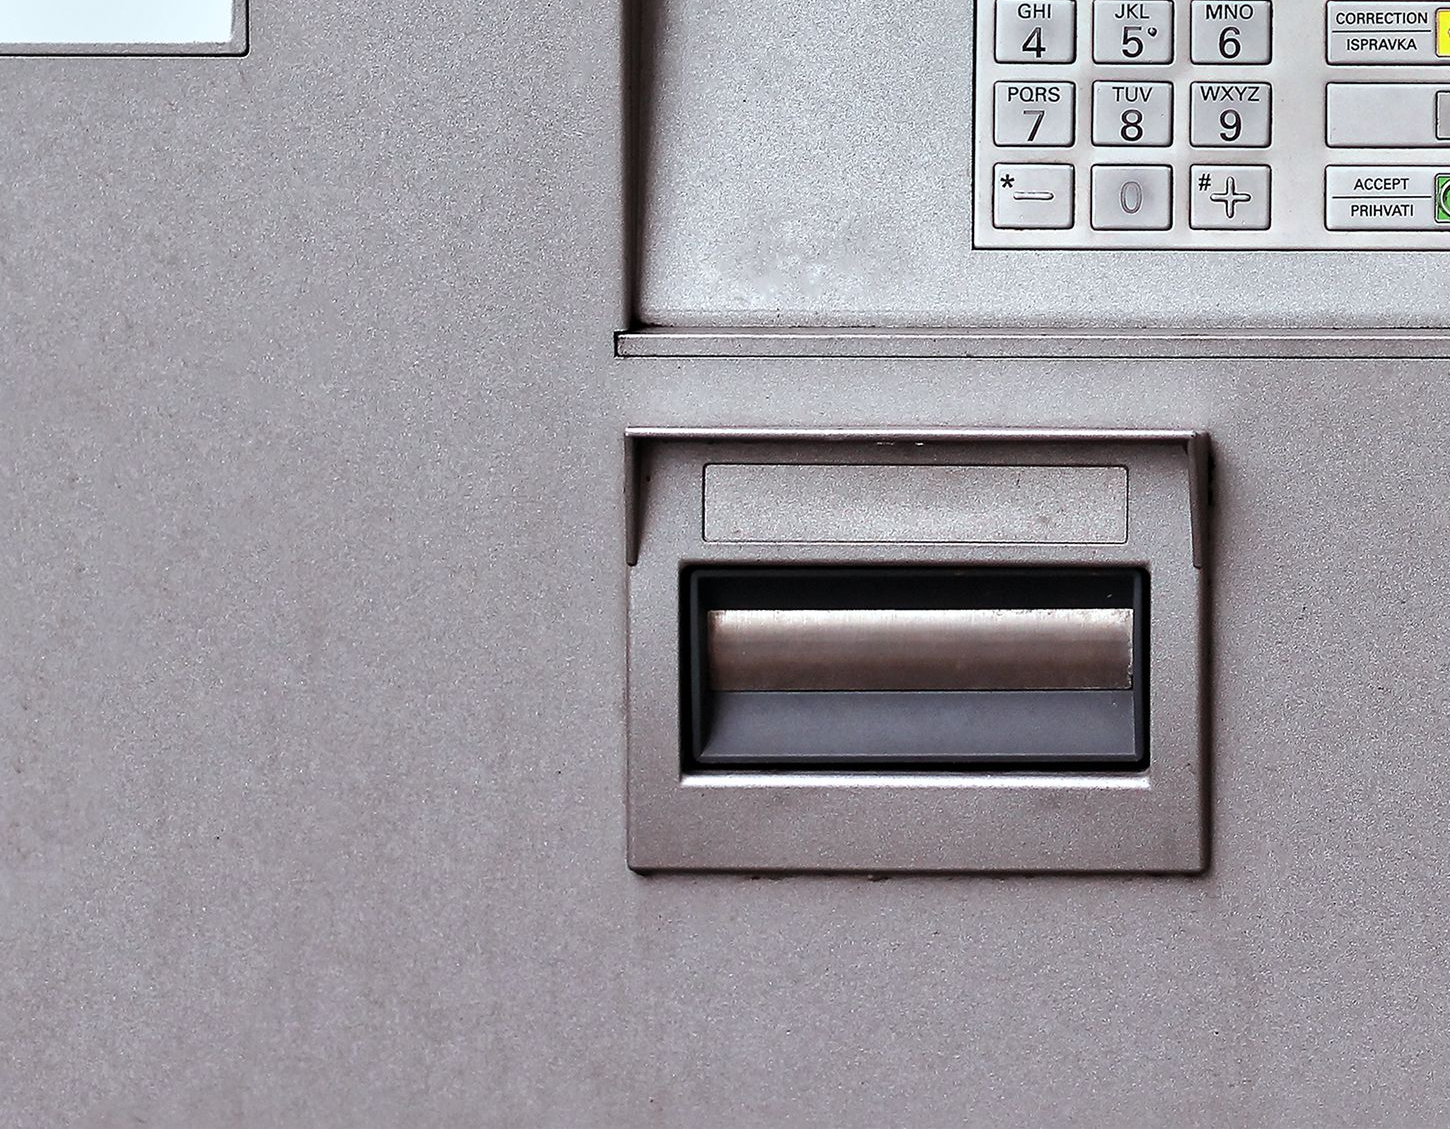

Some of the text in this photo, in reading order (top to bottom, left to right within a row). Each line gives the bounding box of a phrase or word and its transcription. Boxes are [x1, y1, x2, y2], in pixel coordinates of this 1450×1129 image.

[1017, 2, 1052, 19] GHI
[1114, 3, 1150, 20] JKL
[1205, 3, 1254, 20] MNO
[1335, 11, 1428, 25] CORRECTION
[1021, 26, 1047, 59] 4
[1121, 26, 1144, 59] 5
[1218, 26, 1241, 60] 6
[1346, 37, 1418, 52] ISPRAVKA
[1007, 86, 1061, 103] PQRS
[1111, 86, 1153, 103] TUV
[1199, 85, 1260, 102] WXYZ
[1023, 109, 1046, 142] 7
[1120, 109, 1144, 142] 8
[1219, 109, 1242, 142] 9
[1198, 173, 1212, 192] #
[1353, 177, 1410, 191] ACCEPT
[1119, 180, 1143, 214] 0
[1350, 203, 1414, 217] PRIHVATI
